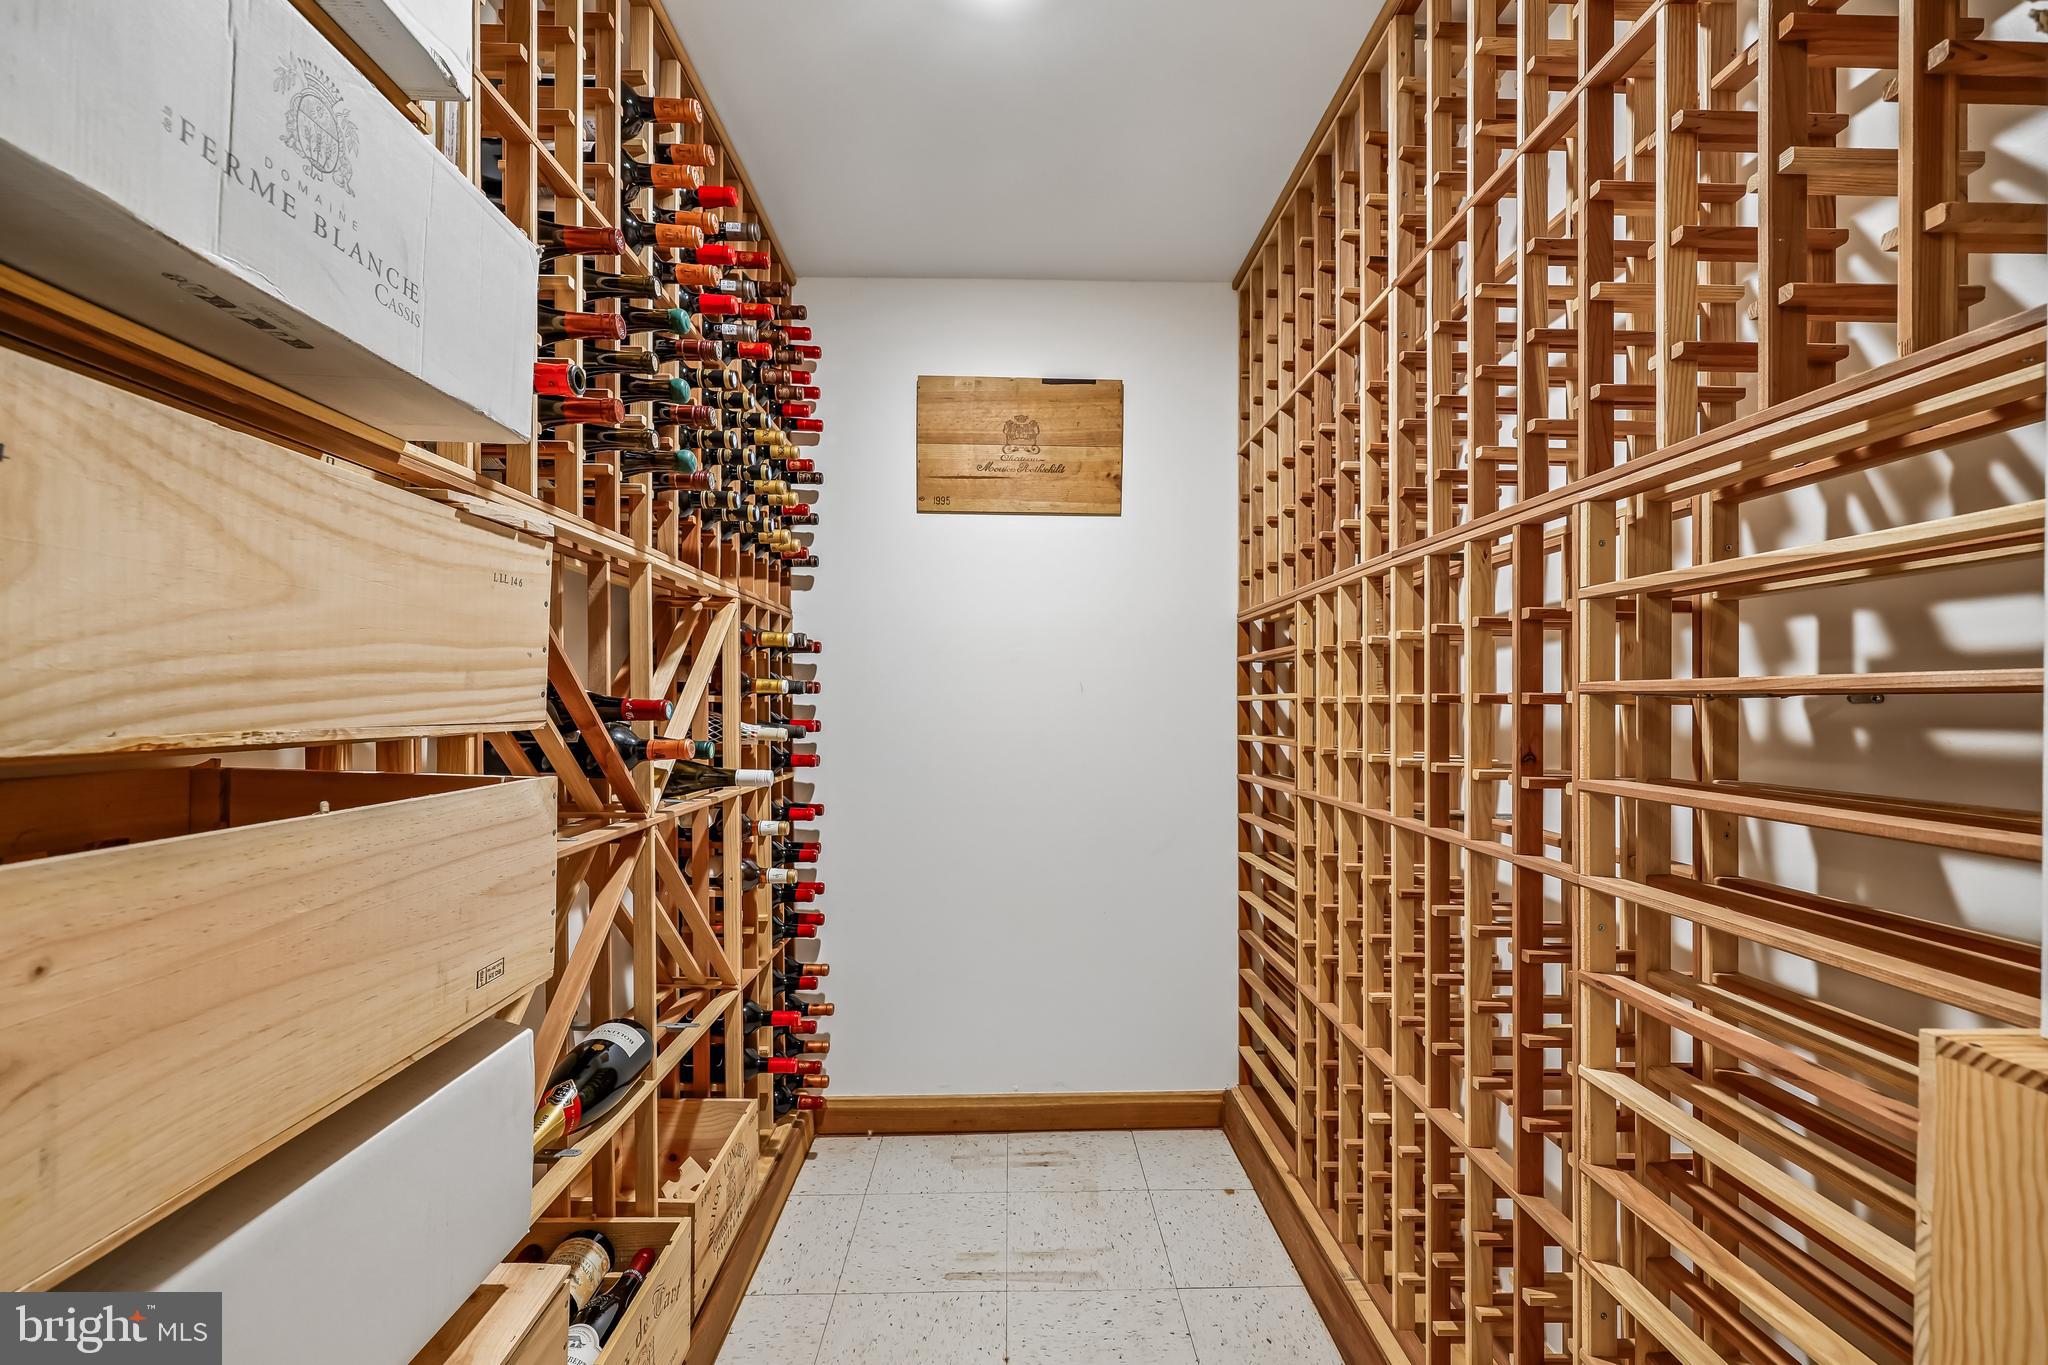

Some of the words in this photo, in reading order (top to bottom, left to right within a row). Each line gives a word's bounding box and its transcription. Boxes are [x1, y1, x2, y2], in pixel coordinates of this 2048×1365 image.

[180, 115, 297, 219] FERME
[313, 211, 419, 304] BLANCHE
[265, 156, 358, 231] DOMAINE
[933, 495, 951, 506] 1995
